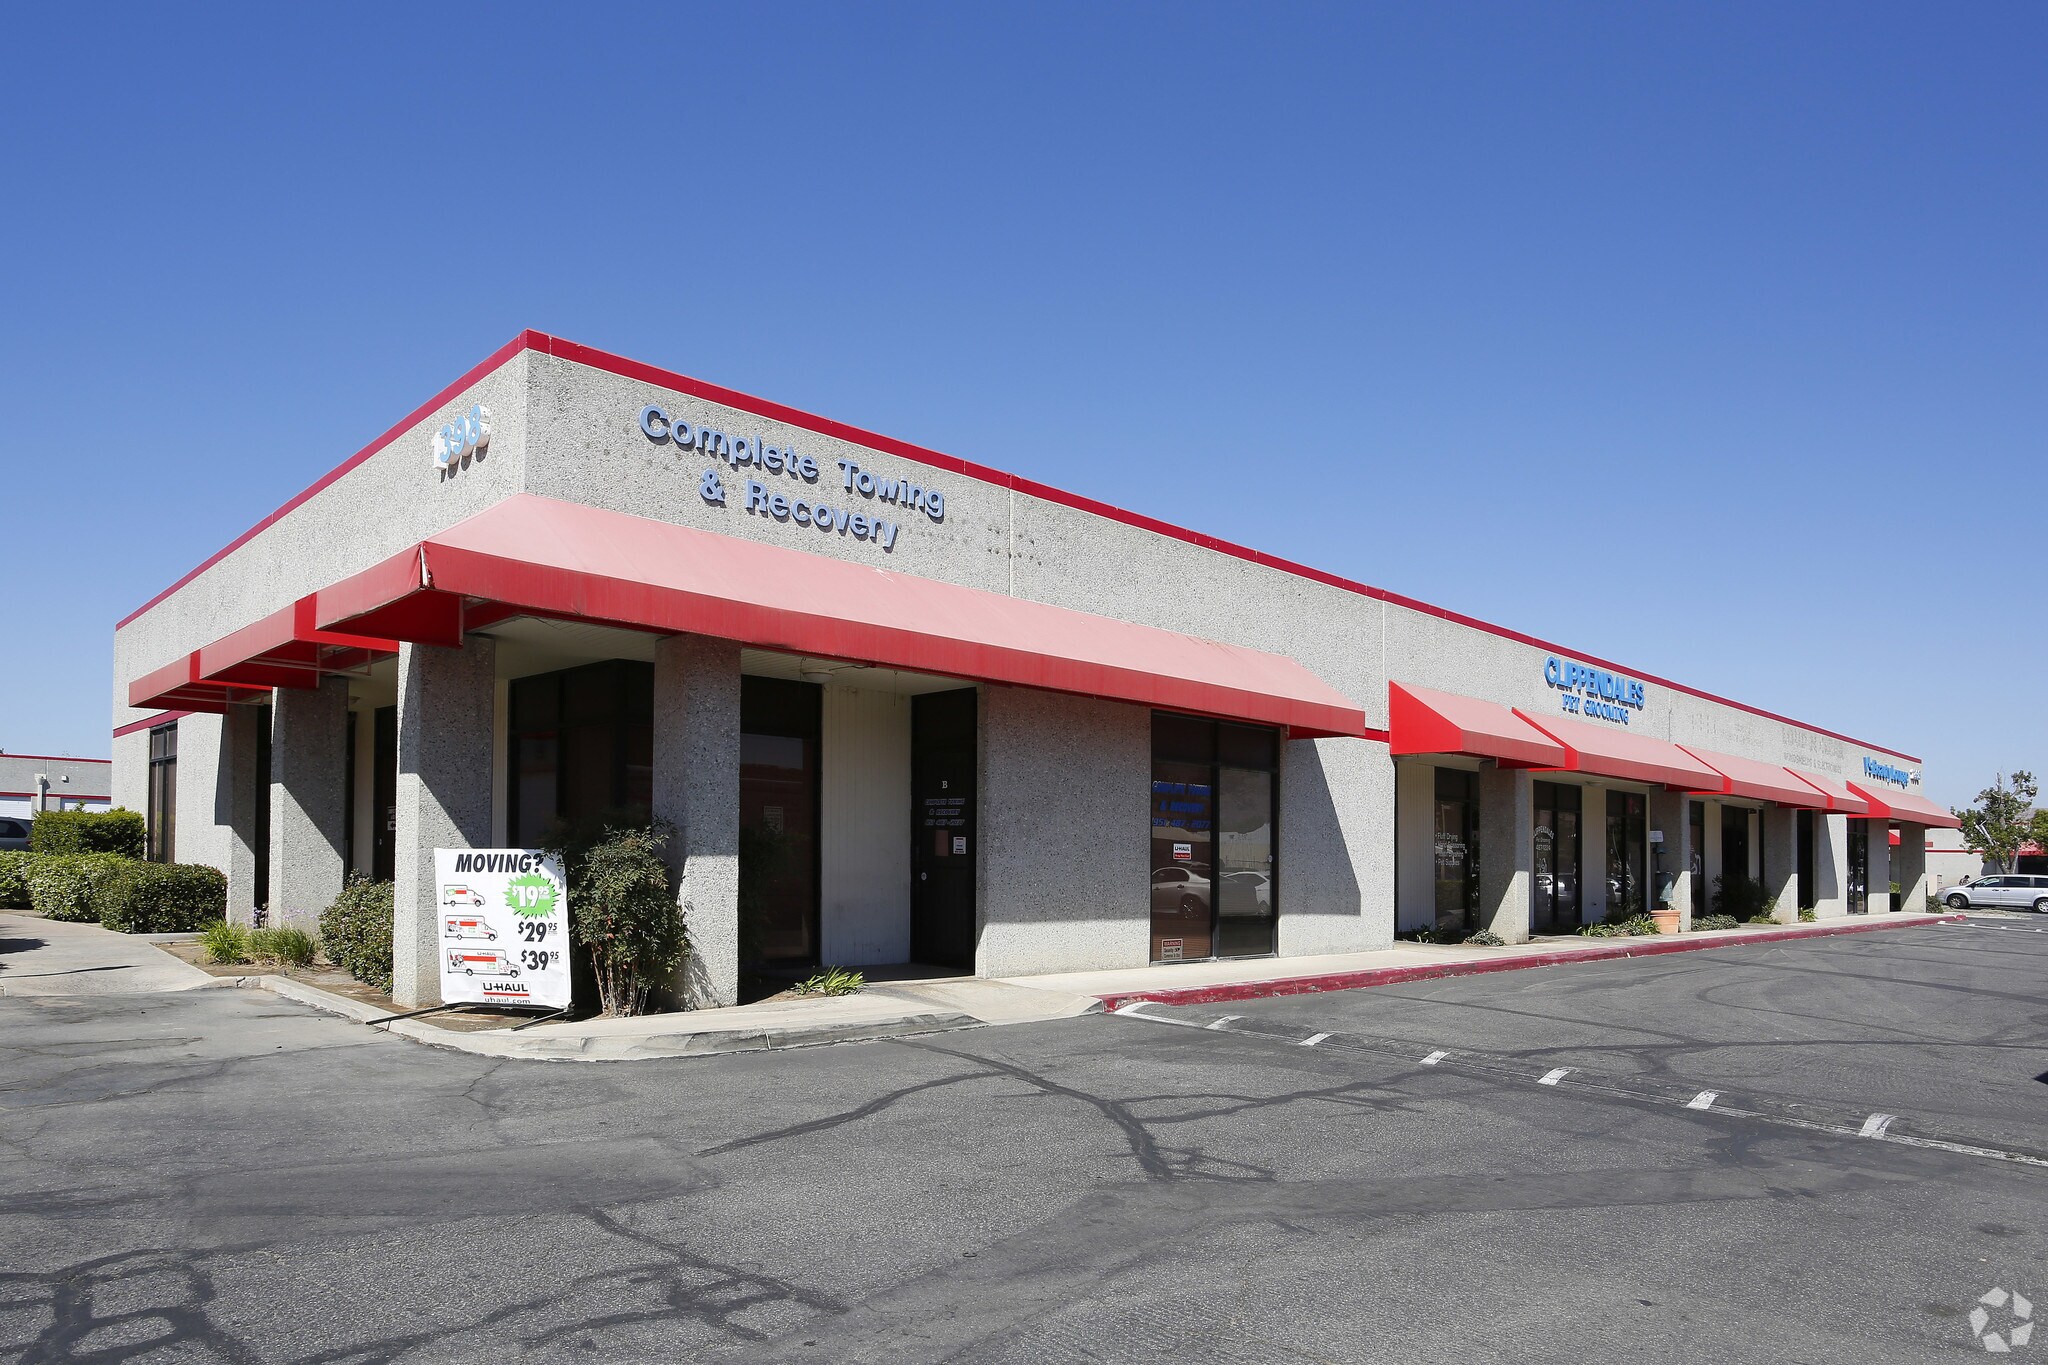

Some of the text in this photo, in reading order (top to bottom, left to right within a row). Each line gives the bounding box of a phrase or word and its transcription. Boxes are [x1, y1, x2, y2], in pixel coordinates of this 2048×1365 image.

[639, 405, 946, 519] Complete Towing
[699, 468, 899, 548] & Recovery
[1544, 656, 1645, 708] CLIPPENDALES
[1562, 694, 1630, 725] PET GROOMING
[942, 780, 948, 789] B
[455, 853, 544, 873] MOVING?
[483, 982, 529, 992] U-HAUL
[484, 996, 531, 1004] uhaul.com
